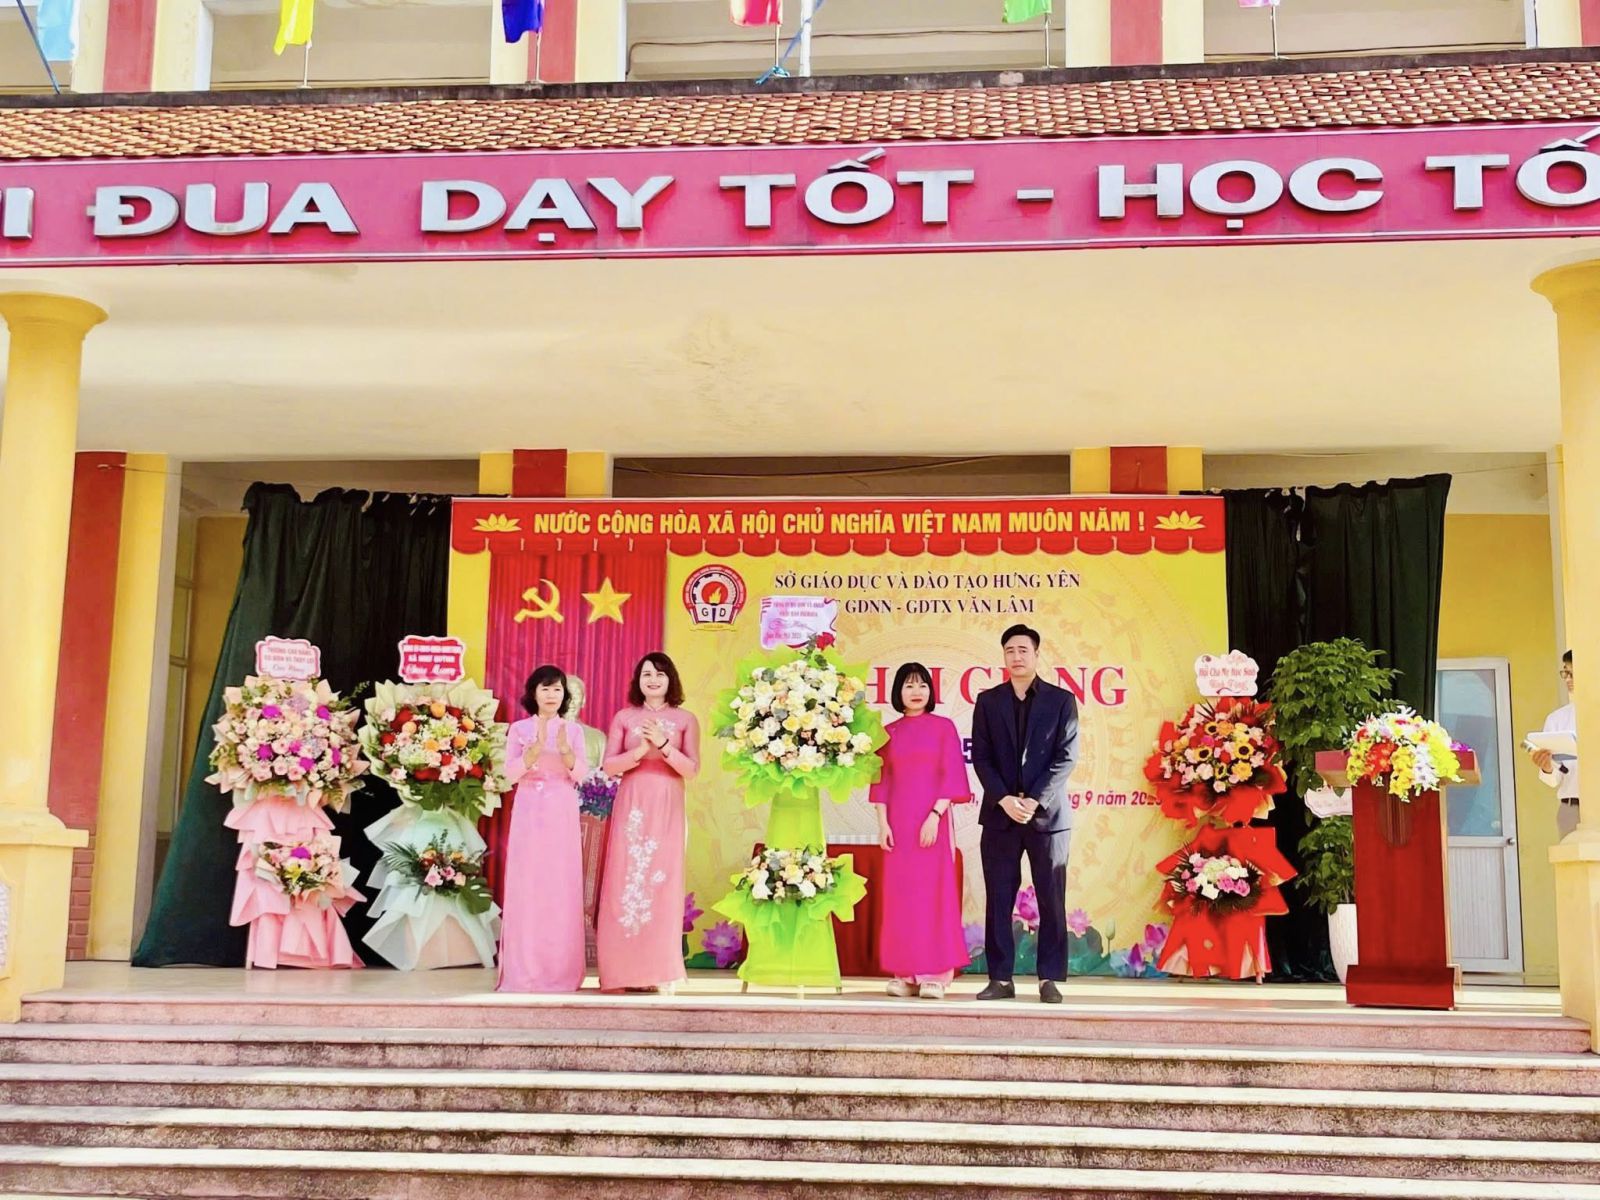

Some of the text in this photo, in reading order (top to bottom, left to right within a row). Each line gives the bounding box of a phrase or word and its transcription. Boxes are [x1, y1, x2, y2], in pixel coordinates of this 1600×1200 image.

[86, 181, 360, 237] ĐUA
[421, 175, 674, 243] DẠY
[719, 147, 975, 229] TỐT
[1016, 188, 1054, 202] -
[1098, 157, 1384, 229] HỌC
[534, 506, 1145, 538] NƯỚC CỘNG HÒA XÃ HỘI CHỦ NGHĨA VIỆT NAM MUÔN NĂM !
[775, 569, 1081, 593] SỞ GIÁO DỤC VÀ ĐÀO TẠO HƯNG YÊN
[845, 599, 892, 614] GDNN
[906, 599, 952, 614] GDTX
[957, 595, 992, 613] VĂN
[996, 594, 1034, 613] LÂM
[865, 666, 1128, 706] HI GNG
[1085, 790, 1093, 805] 9
[1096, 790, 1127, 806] năm
